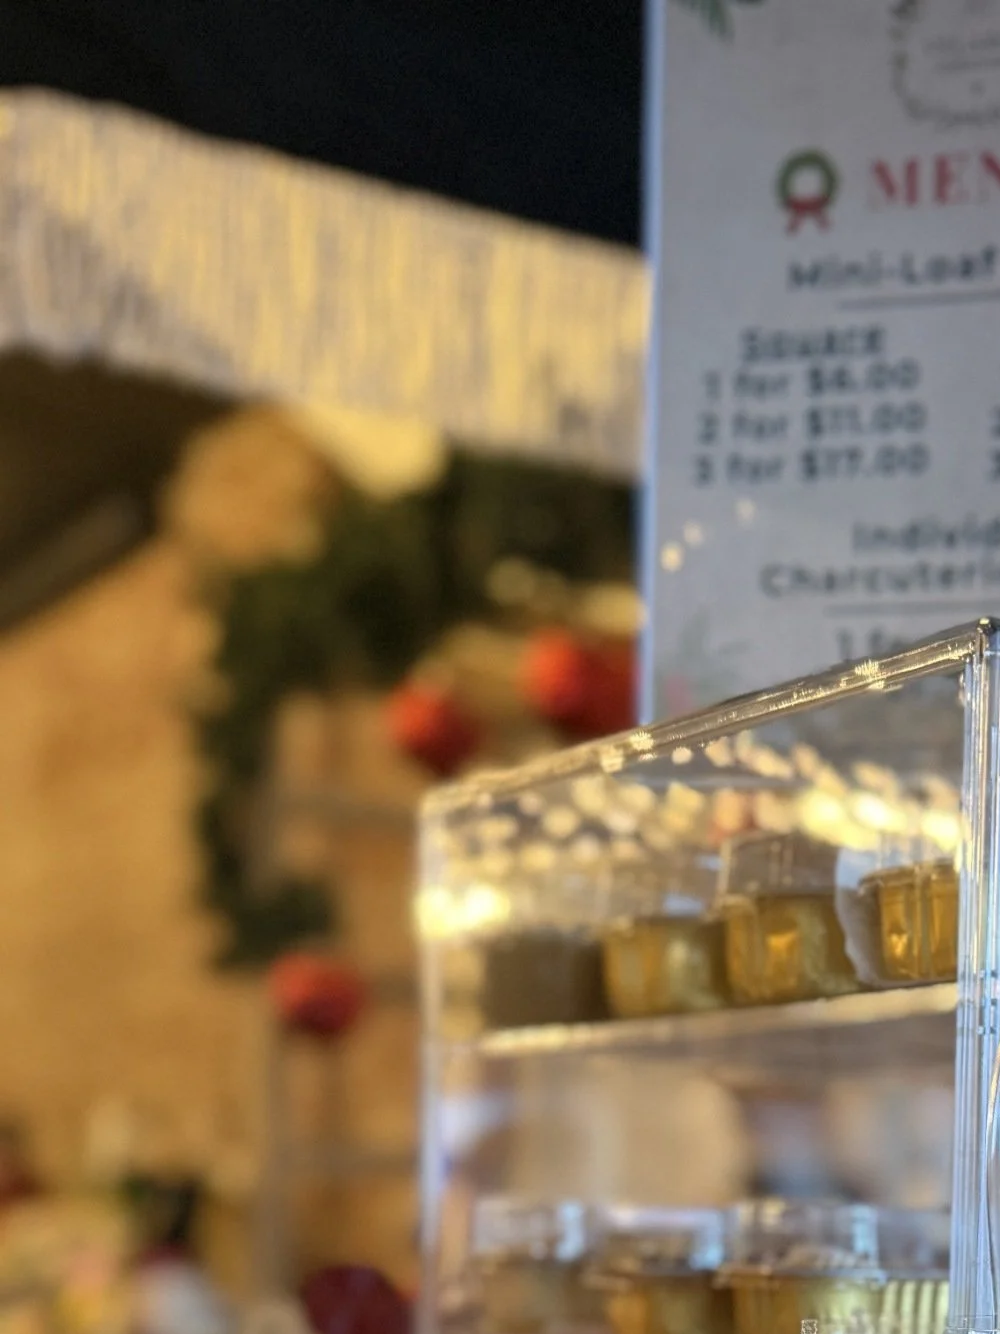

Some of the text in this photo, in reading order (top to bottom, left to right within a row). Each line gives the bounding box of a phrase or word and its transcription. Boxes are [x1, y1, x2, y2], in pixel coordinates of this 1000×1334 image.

[787, 243, 998, 291] Mini-Loaf
[732, 368, 790, 399] for
[731, 409, 788, 440] for
[725, 450, 784, 484] for
